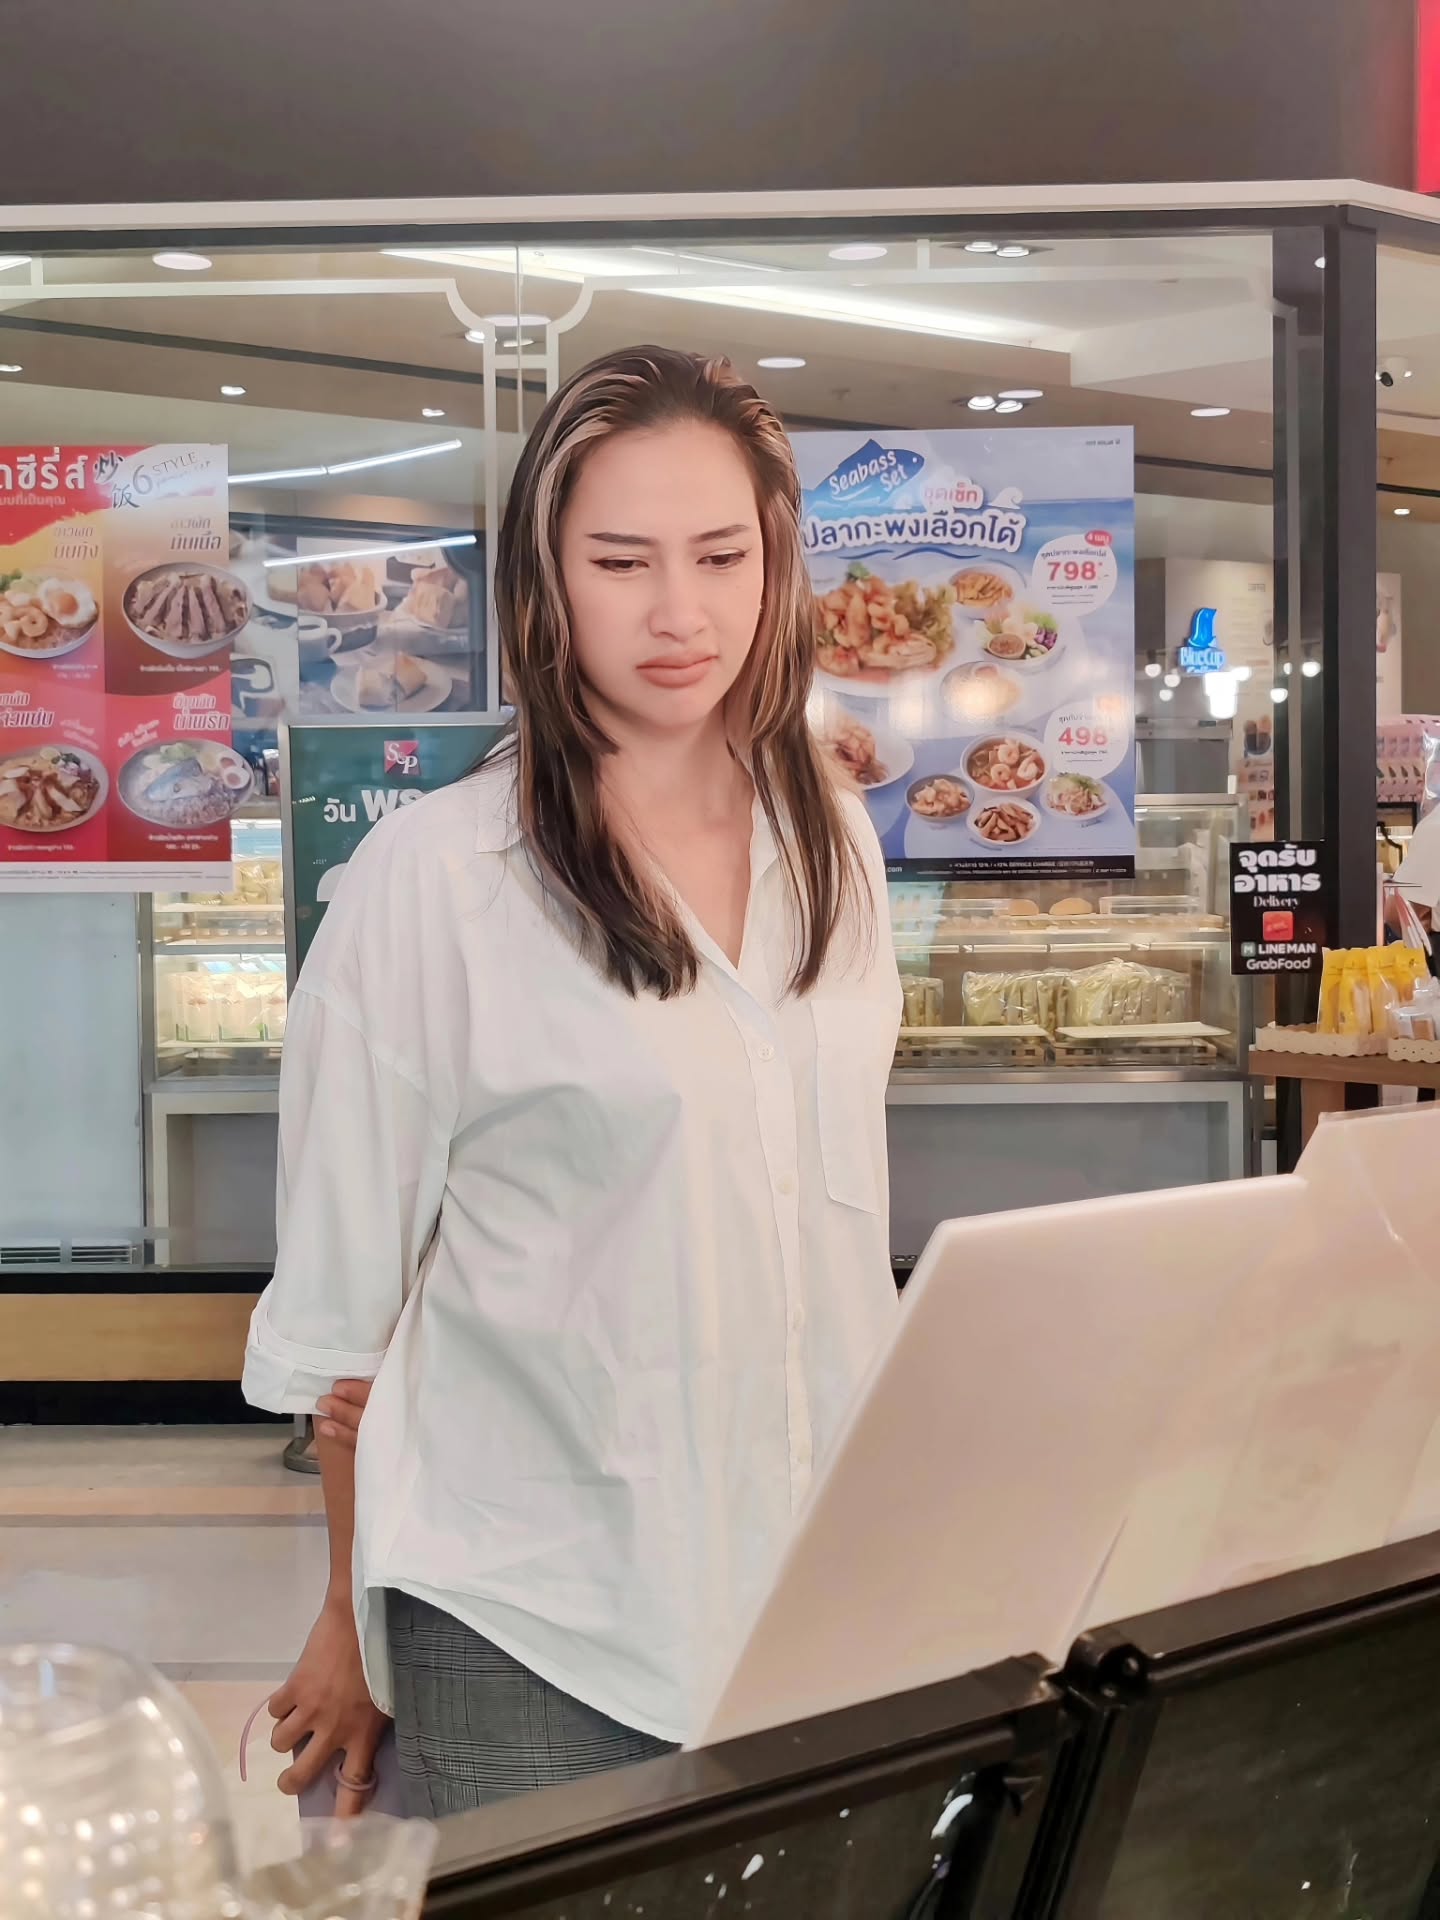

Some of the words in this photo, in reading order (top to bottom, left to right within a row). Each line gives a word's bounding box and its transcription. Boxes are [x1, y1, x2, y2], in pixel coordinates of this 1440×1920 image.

[133, 464, 153, 495] 6
[152, 451, 197, 473] STYLE
[829, 450, 897, 496] Seabass
[880, 463, 908, 493] Set
[801, 510, 1019, 549] ปลากะพงเลือกได้
[323, 797, 357, 823] วัน
[1238, 843, 1317, 873] จุดรับ
[1234, 873, 1321, 893] อาหาร
[1253, 895, 1298, 910] Delivery
[1258, 943, 1285, 955] LINE
[1287, 942, 1316, 954] MAN
[1246, 957, 1311, 971] GrabFood
